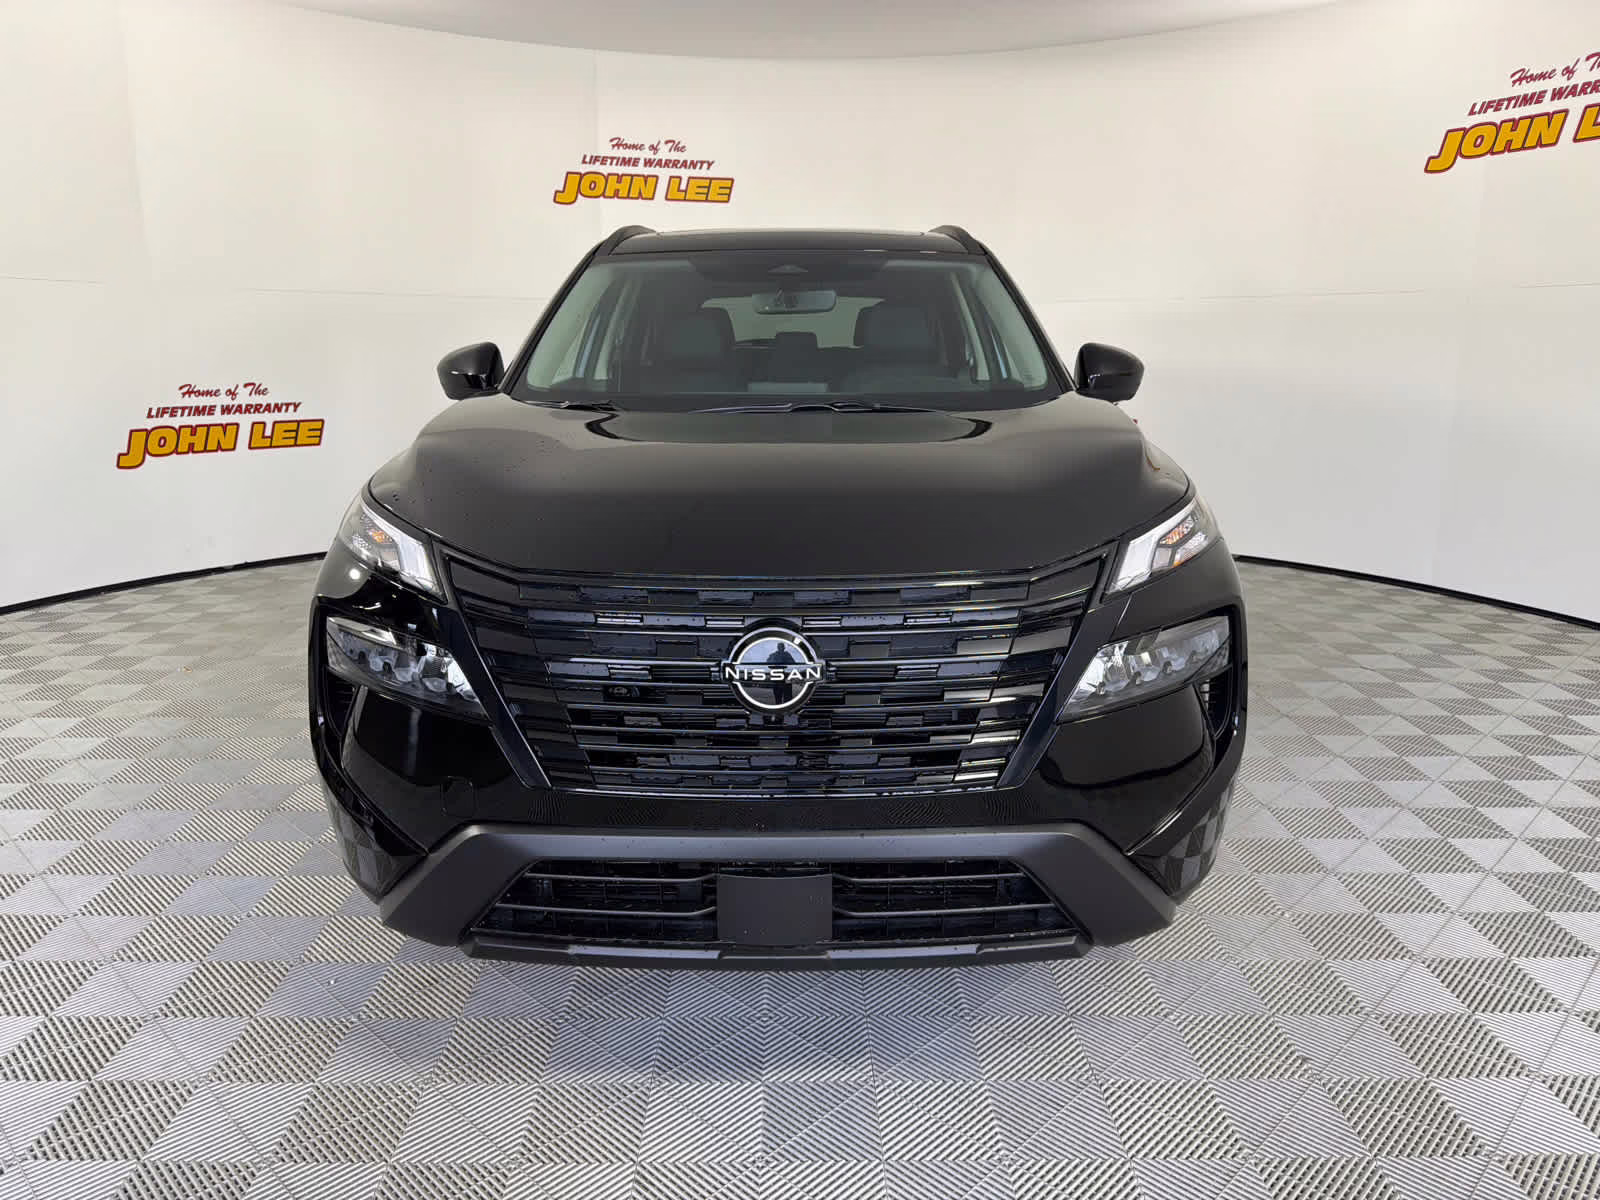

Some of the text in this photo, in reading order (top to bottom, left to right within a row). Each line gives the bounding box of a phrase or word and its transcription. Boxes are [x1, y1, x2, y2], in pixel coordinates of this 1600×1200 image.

[1510, 67, 1557, 87] Home
[1561, 58, 1581, 81] of
[1468, 90, 1548, 116] LIFETIME
[609, 137, 687, 155] Home of The
[1424, 109, 1569, 173] JOHN
[581, 154, 715, 170] LIFETIME WARRANTY
[553, 171, 735, 205] JOHN LEE
[178, 382, 270, 400] Home of The
[146, 402, 302, 419] LIFETIME WARRANTY
[117, 419, 325, 469] JOHN LEE
[725, 666, 821, 681] NISSAN
